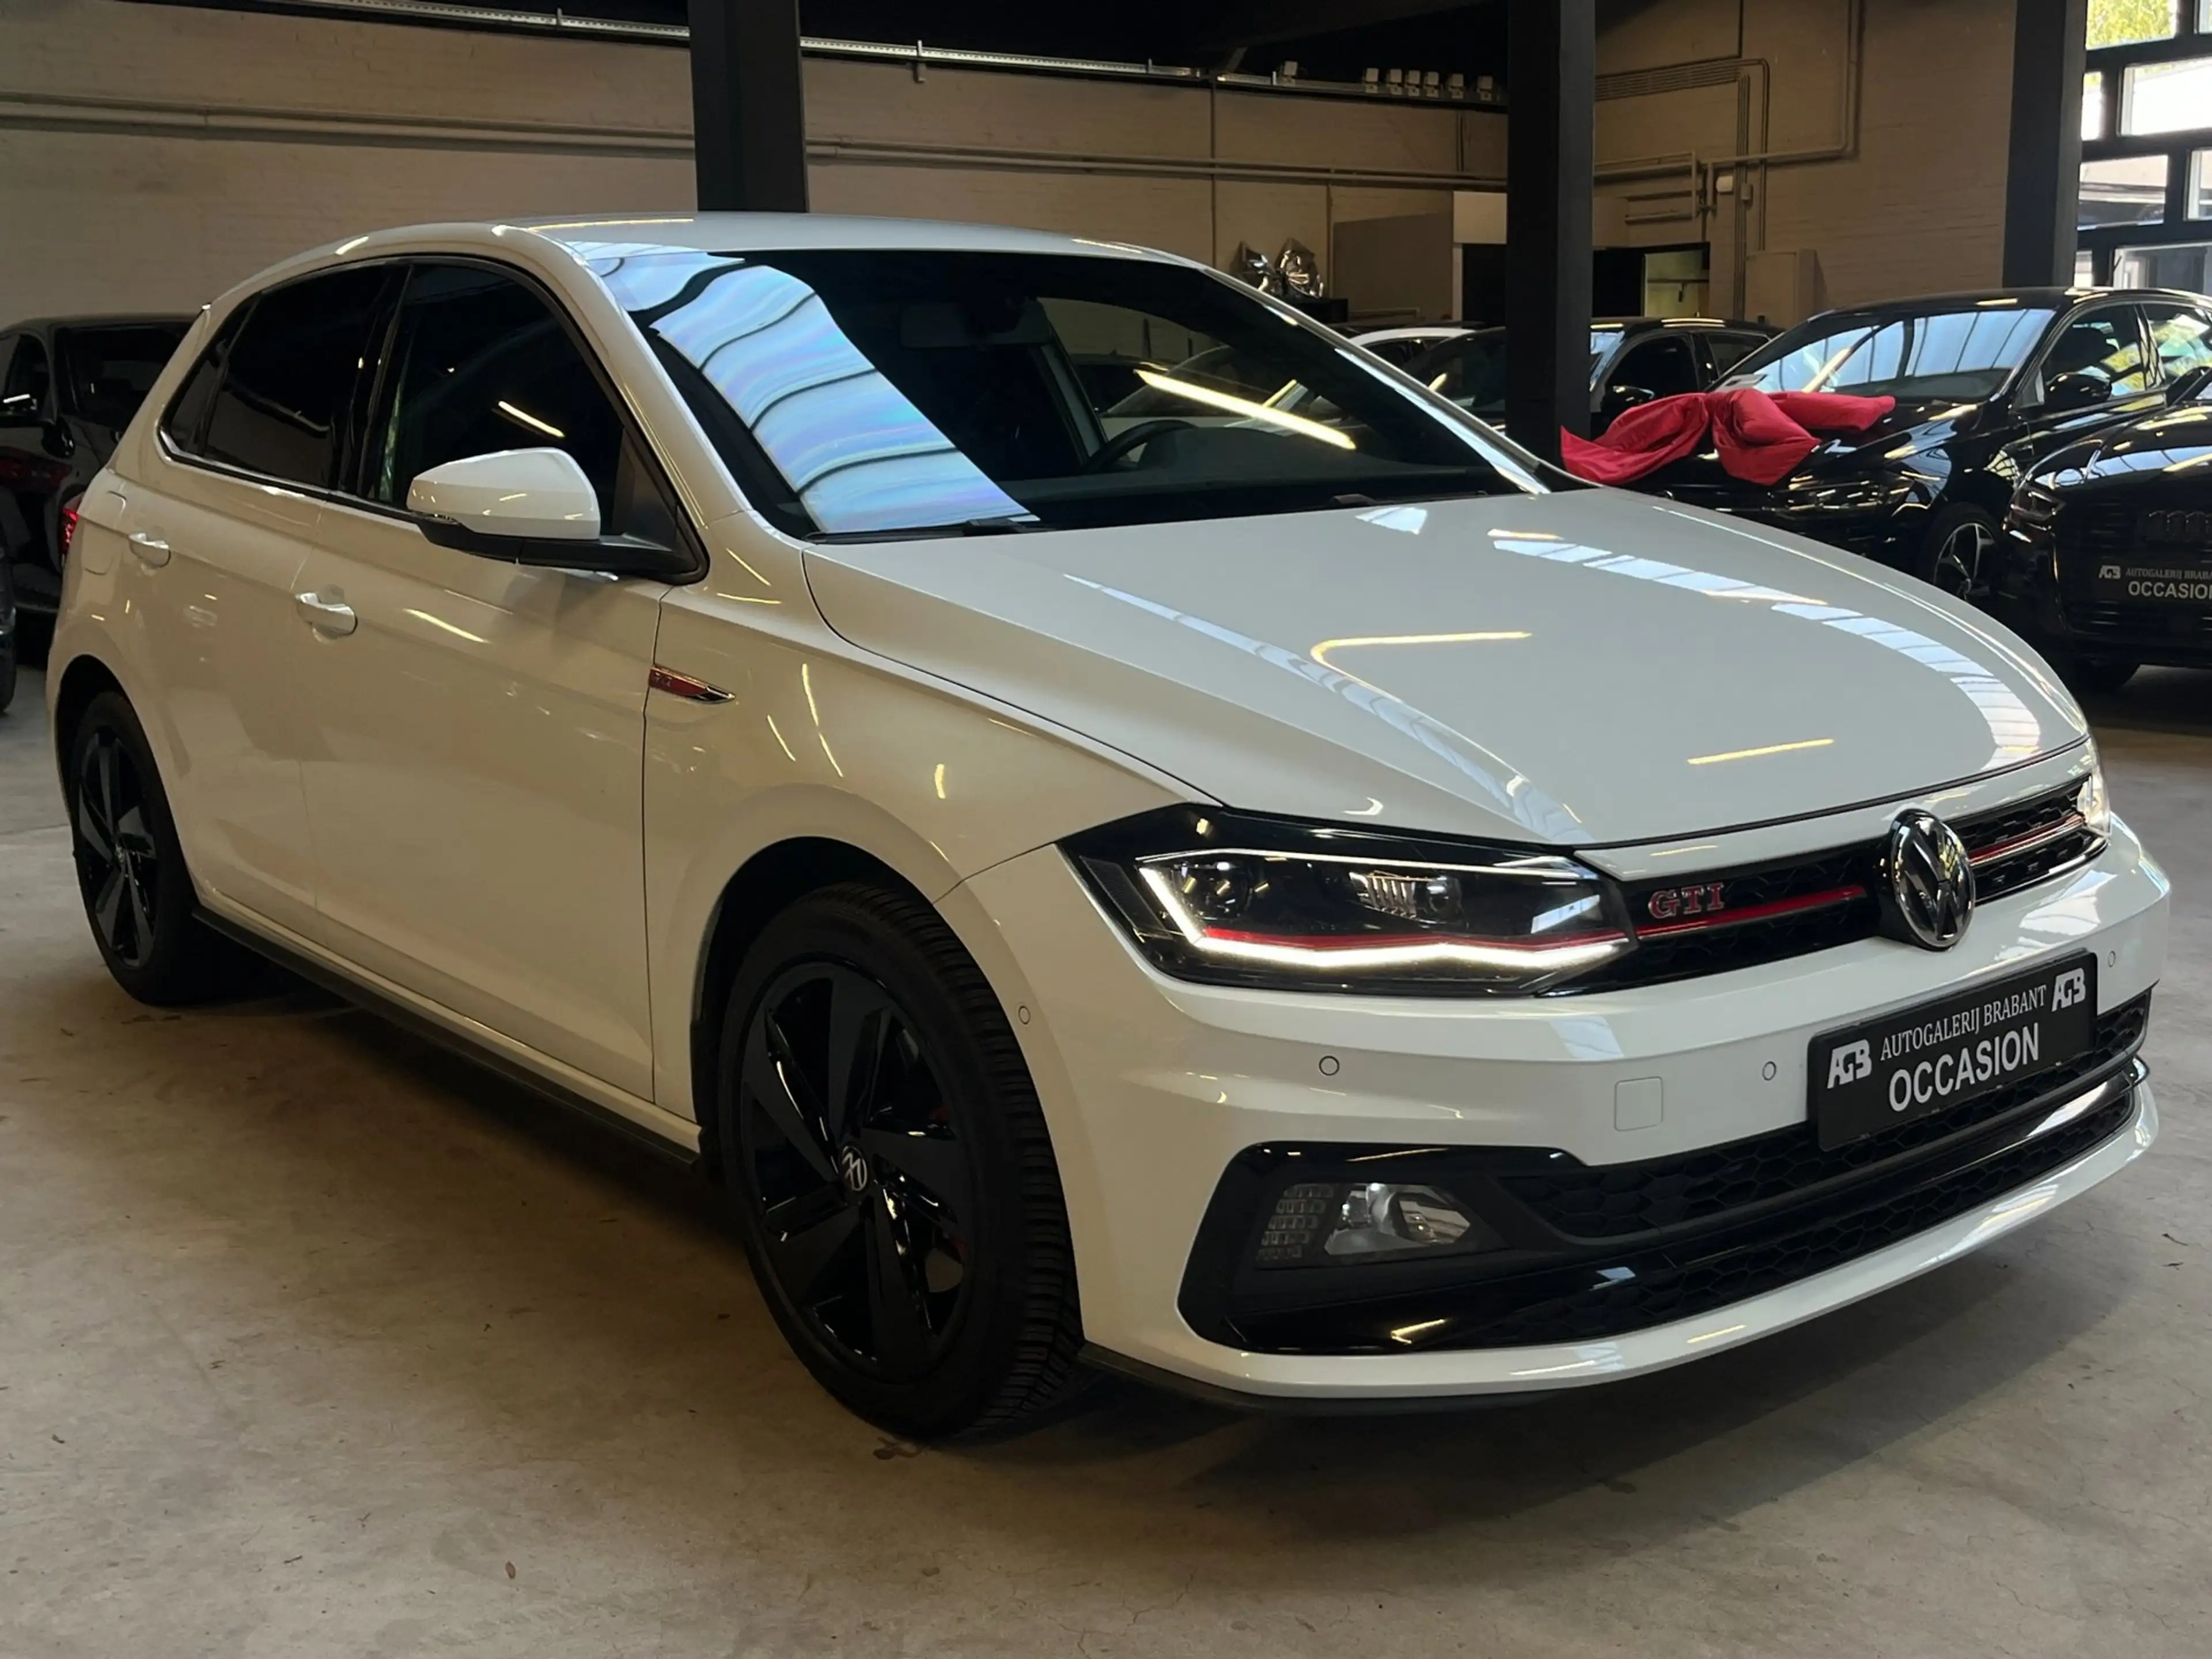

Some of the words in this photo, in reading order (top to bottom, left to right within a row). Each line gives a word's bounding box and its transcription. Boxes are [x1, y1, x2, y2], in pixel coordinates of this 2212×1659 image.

[1648, 882, 1725, 919] GTI
[1826, 1039, 1872, 1089] AGB
[1880, 1007, 1980, 1061] AUTOGALERIJ
[1983, 985, 2047, 1027] BRABANT
[2052, 967, 2086, 1012] AGB
[1889, 1022, 2039, 1112] OCCASION
